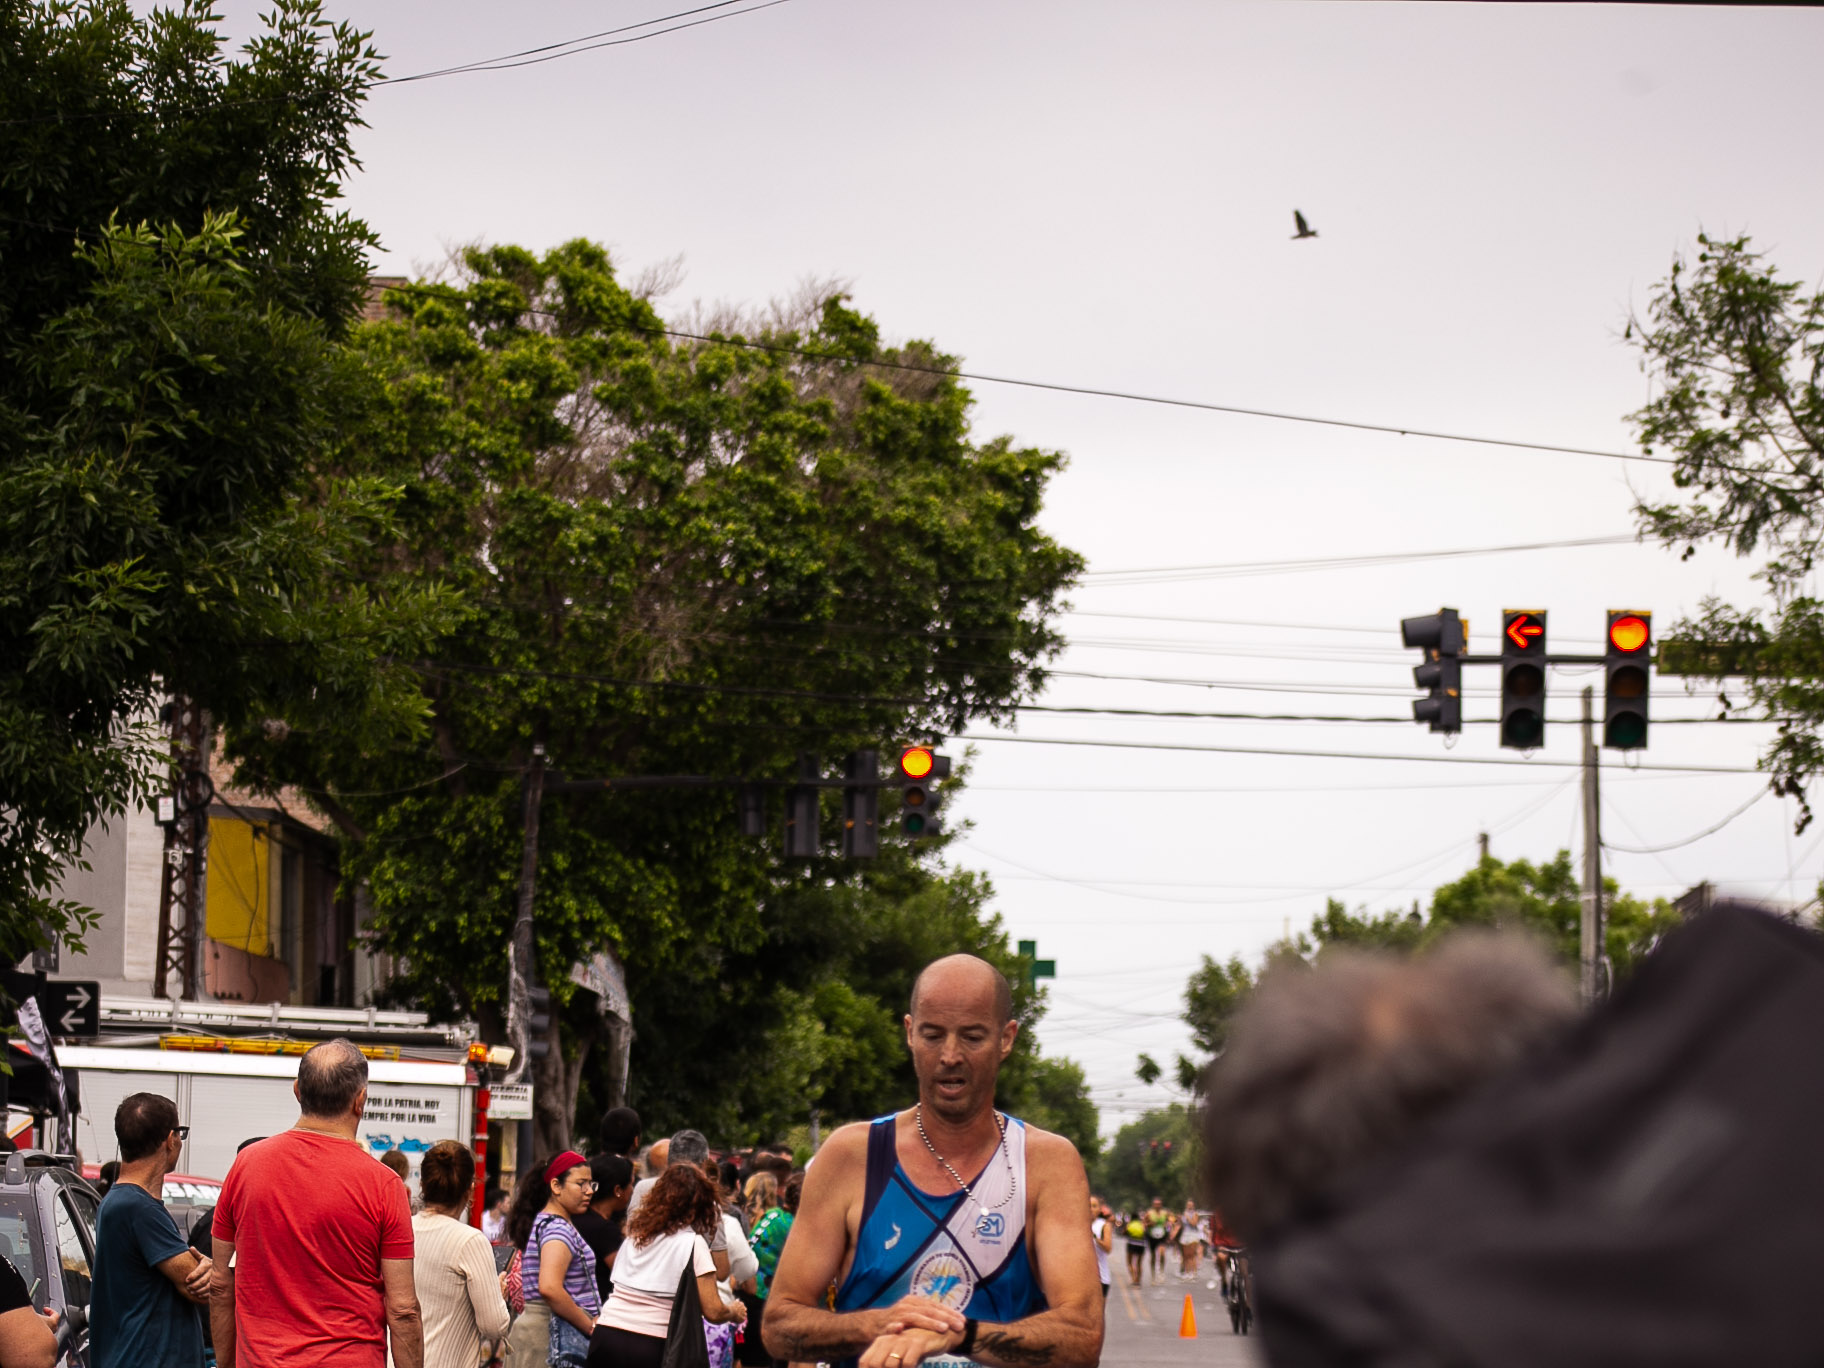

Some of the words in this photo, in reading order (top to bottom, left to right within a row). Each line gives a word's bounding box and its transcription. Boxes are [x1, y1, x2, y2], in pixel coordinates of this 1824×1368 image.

[367, 1097, 382, 1107] POR
[384, 1098, 393, 1108] LA
[425, 1100, 440, 1110] HOY
[363, 1111, 389, 1122] EMPRE
[390, 1112, 405, 1122] POR
[407, 1113, 416, 1123] LA
[418, 1114, 436, 1124] VIDA
